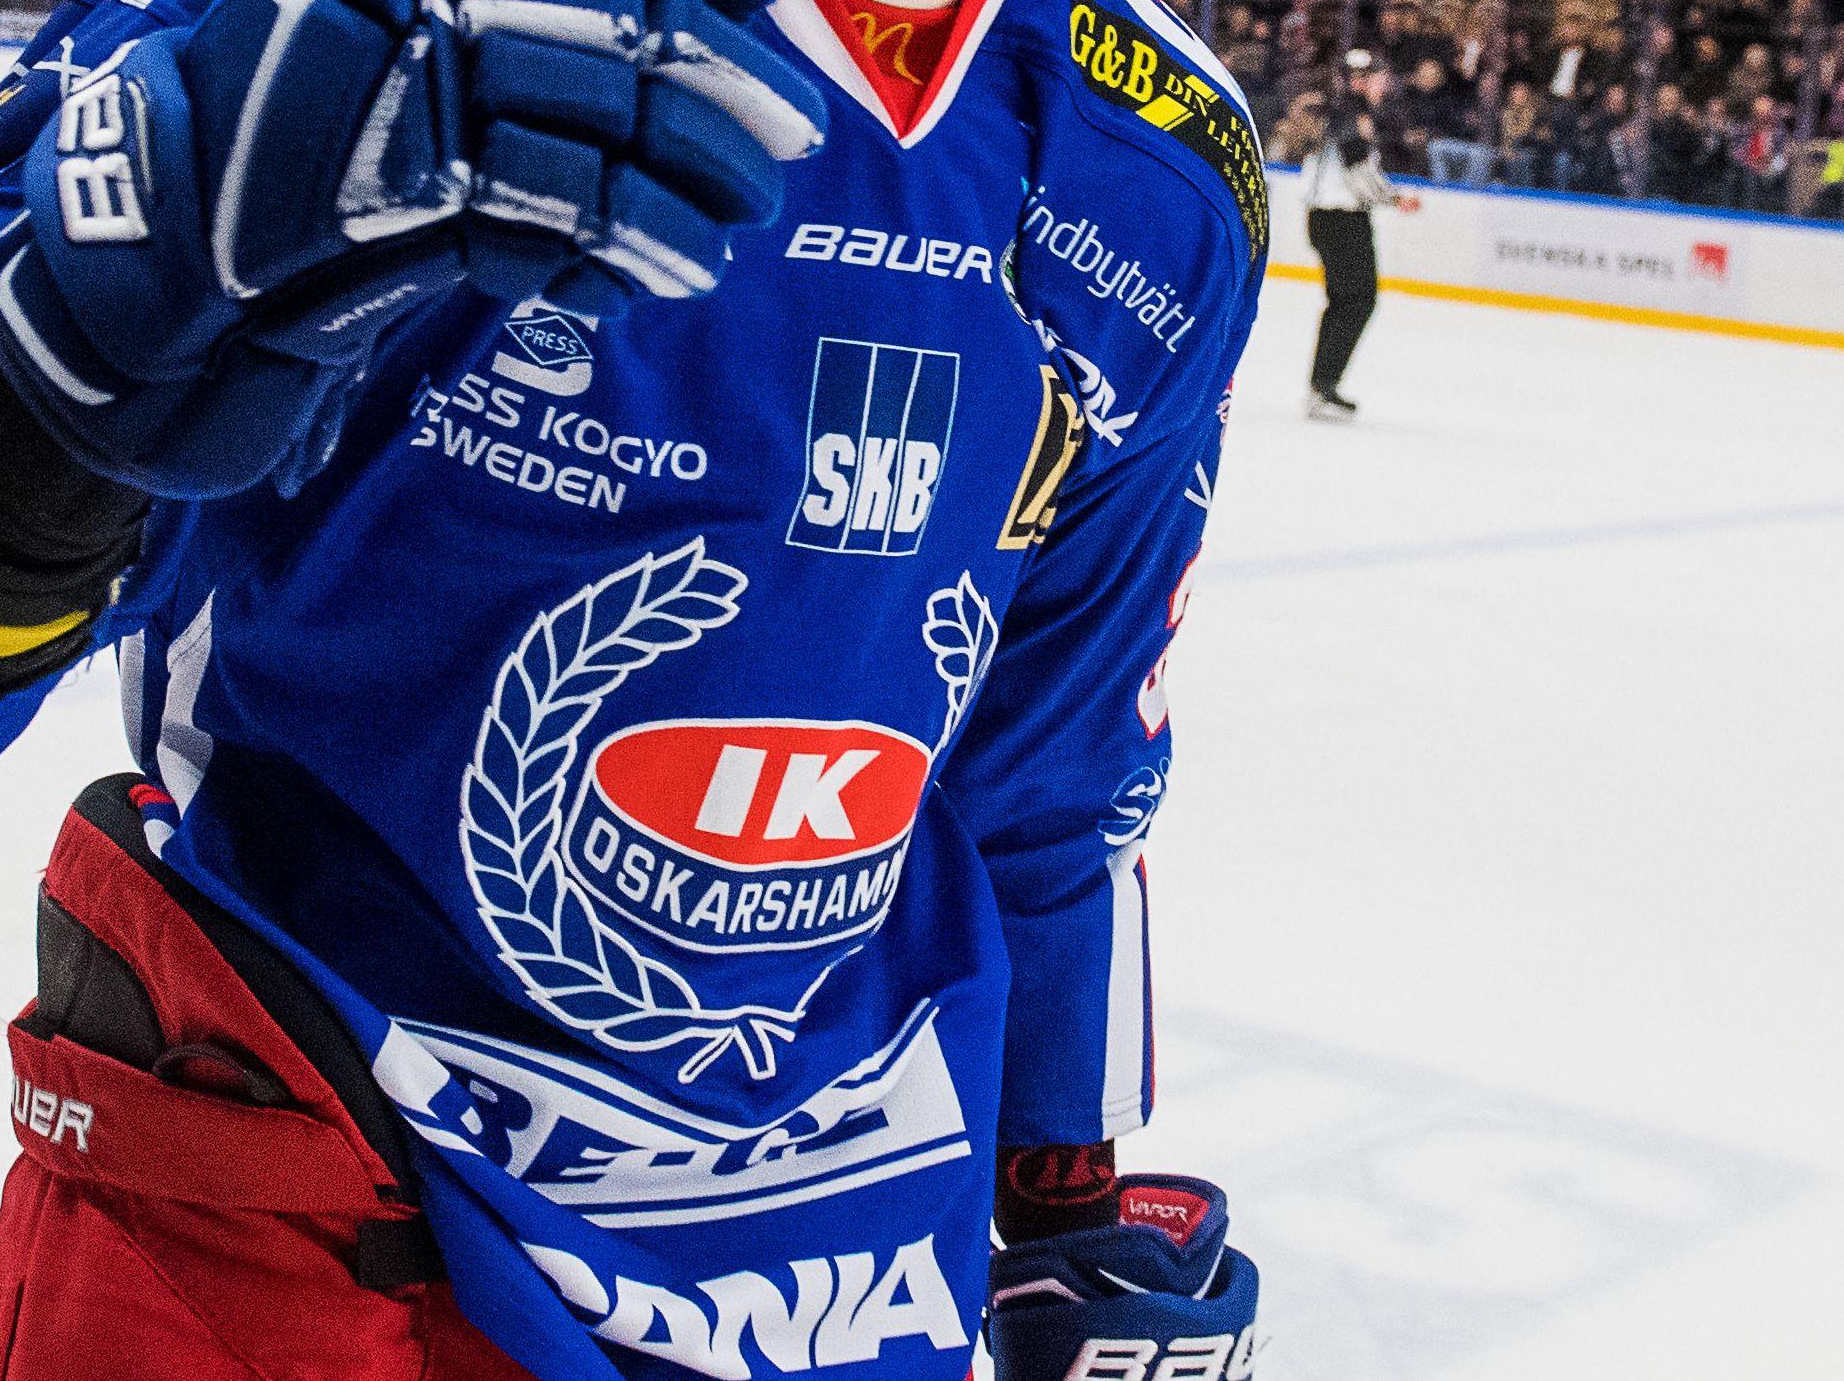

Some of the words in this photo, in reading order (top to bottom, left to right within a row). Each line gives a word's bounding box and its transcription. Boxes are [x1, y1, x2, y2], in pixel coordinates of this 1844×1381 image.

[1068, 4, 1159, 104] G&B
[785, 222, 993, 285] BAUER
[1022, 184, 1200, 355] indbytvätt
[521, 326, 580, 356] PRESS
[539, 405, 708, 482] KOGYO
[803, 433, 943, 534] SKB
[694, 744, 882, 841] IK
[12, 1074, 95, 1153] UER
